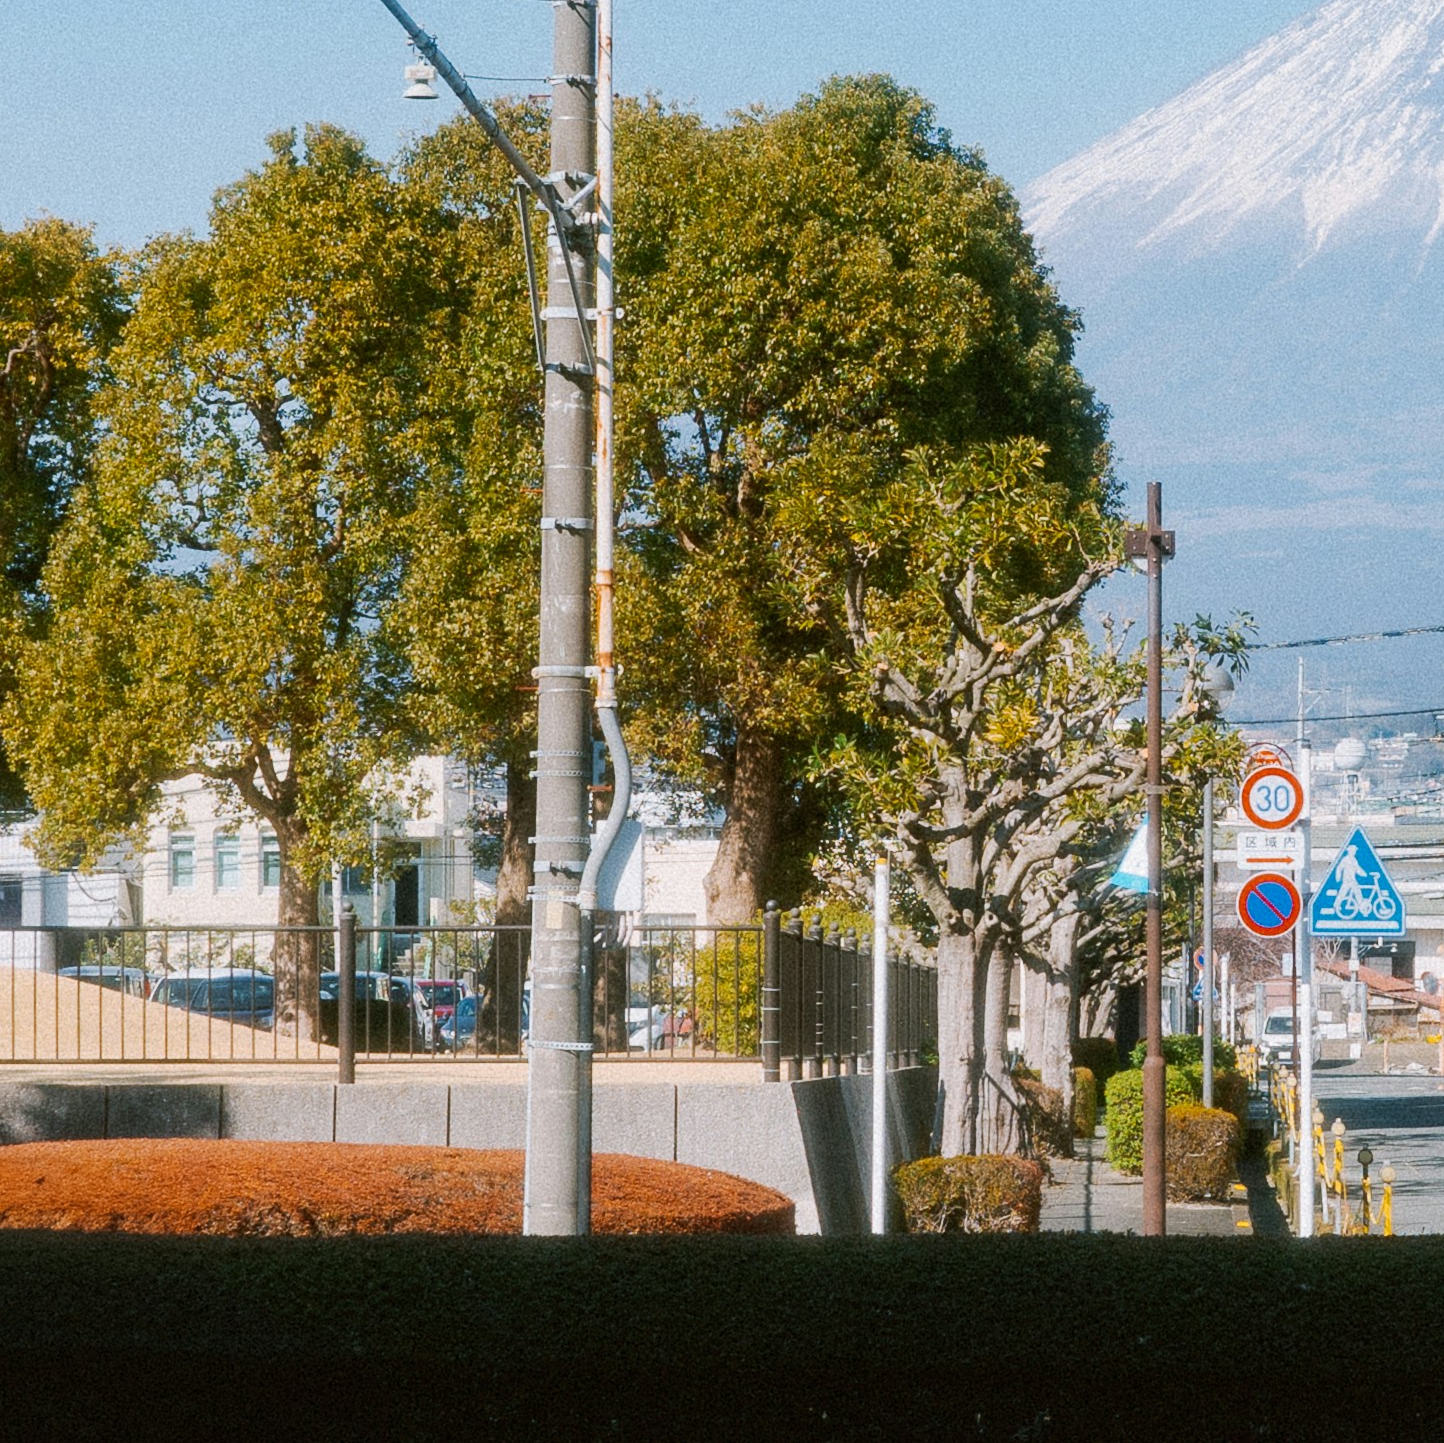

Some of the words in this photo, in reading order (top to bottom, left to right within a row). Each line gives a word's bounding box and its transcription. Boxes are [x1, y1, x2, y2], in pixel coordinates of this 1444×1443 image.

[1256, 785, 1290, 812] 30
[1246, 837, 1296, 849] 区域内
